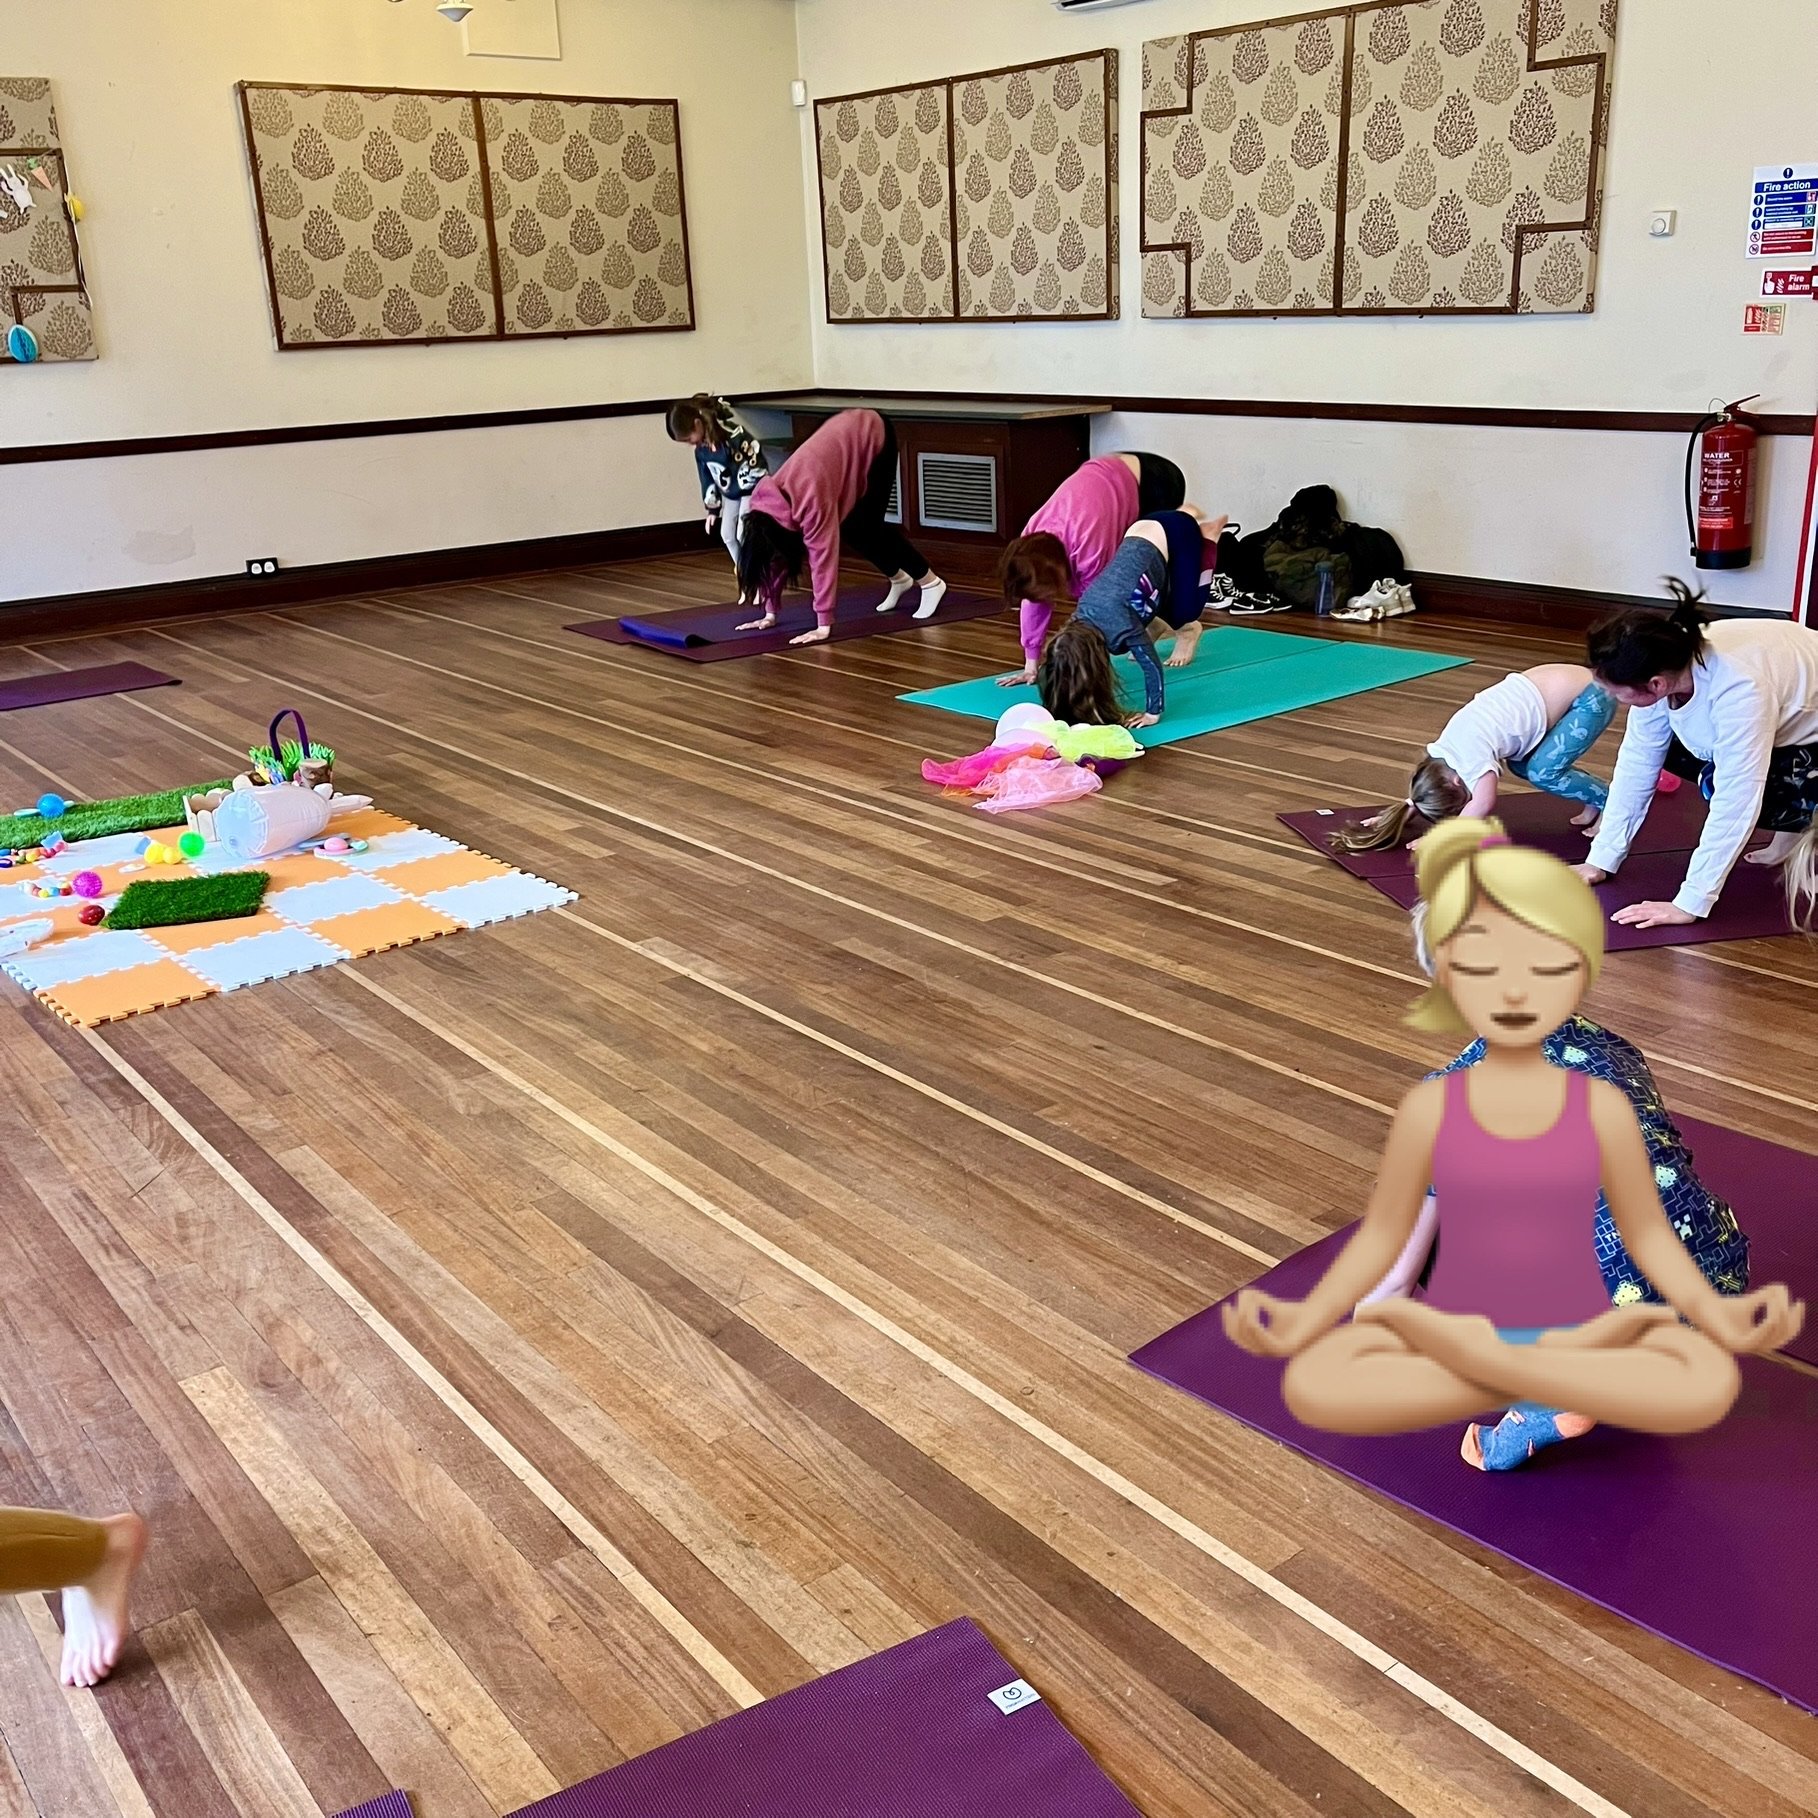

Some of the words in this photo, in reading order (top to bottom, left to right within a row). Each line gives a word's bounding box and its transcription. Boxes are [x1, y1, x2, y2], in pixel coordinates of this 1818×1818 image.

[1763, 182, 1782, 192] Fire
[1783, 181, 1811, 190] action
[1788, 274, 1805, 282] Fire
[1787, 283, 1810, 291] alarm
